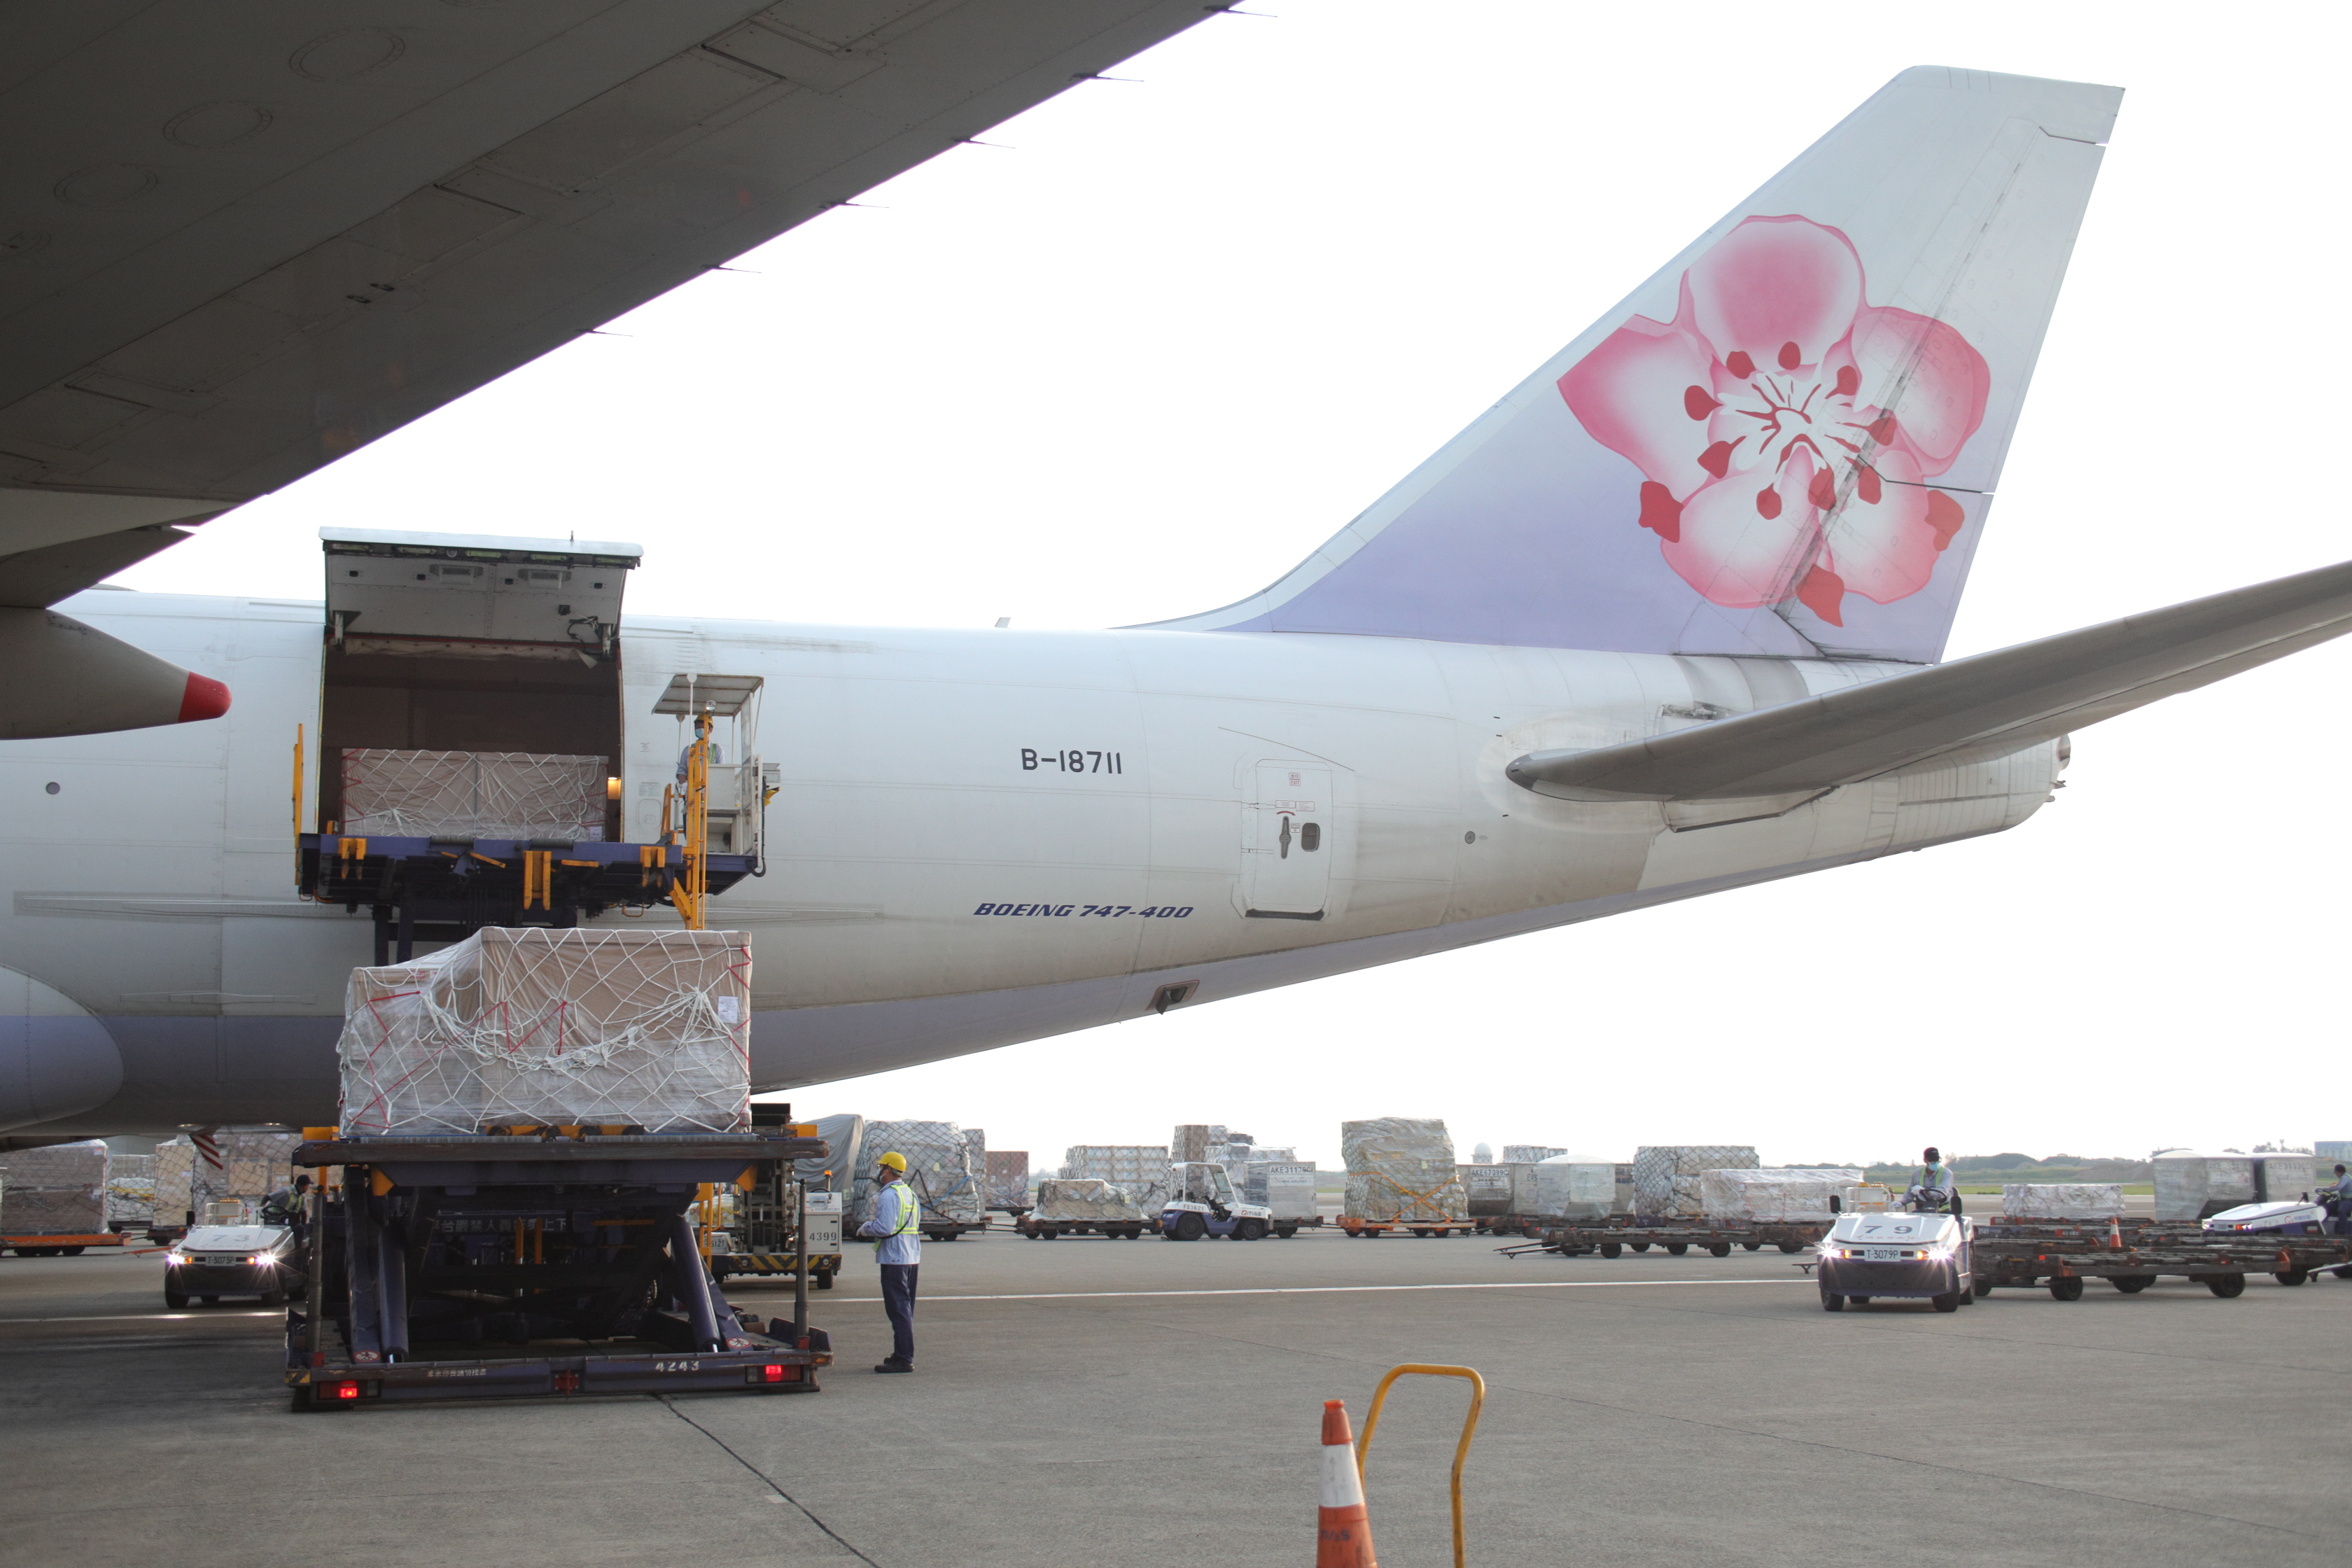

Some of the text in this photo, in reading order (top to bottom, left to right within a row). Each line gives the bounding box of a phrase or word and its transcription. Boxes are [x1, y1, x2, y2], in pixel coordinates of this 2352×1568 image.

[1021, 748, 1122, 774] B-18711
[973, 903, 1194, 918] BOEING 747-400
[809, 1232, 837, 1241] 4399
[1866, 1250, 1898, 1259] T-3079P
[655, 1361, 699, 1372] 4243
